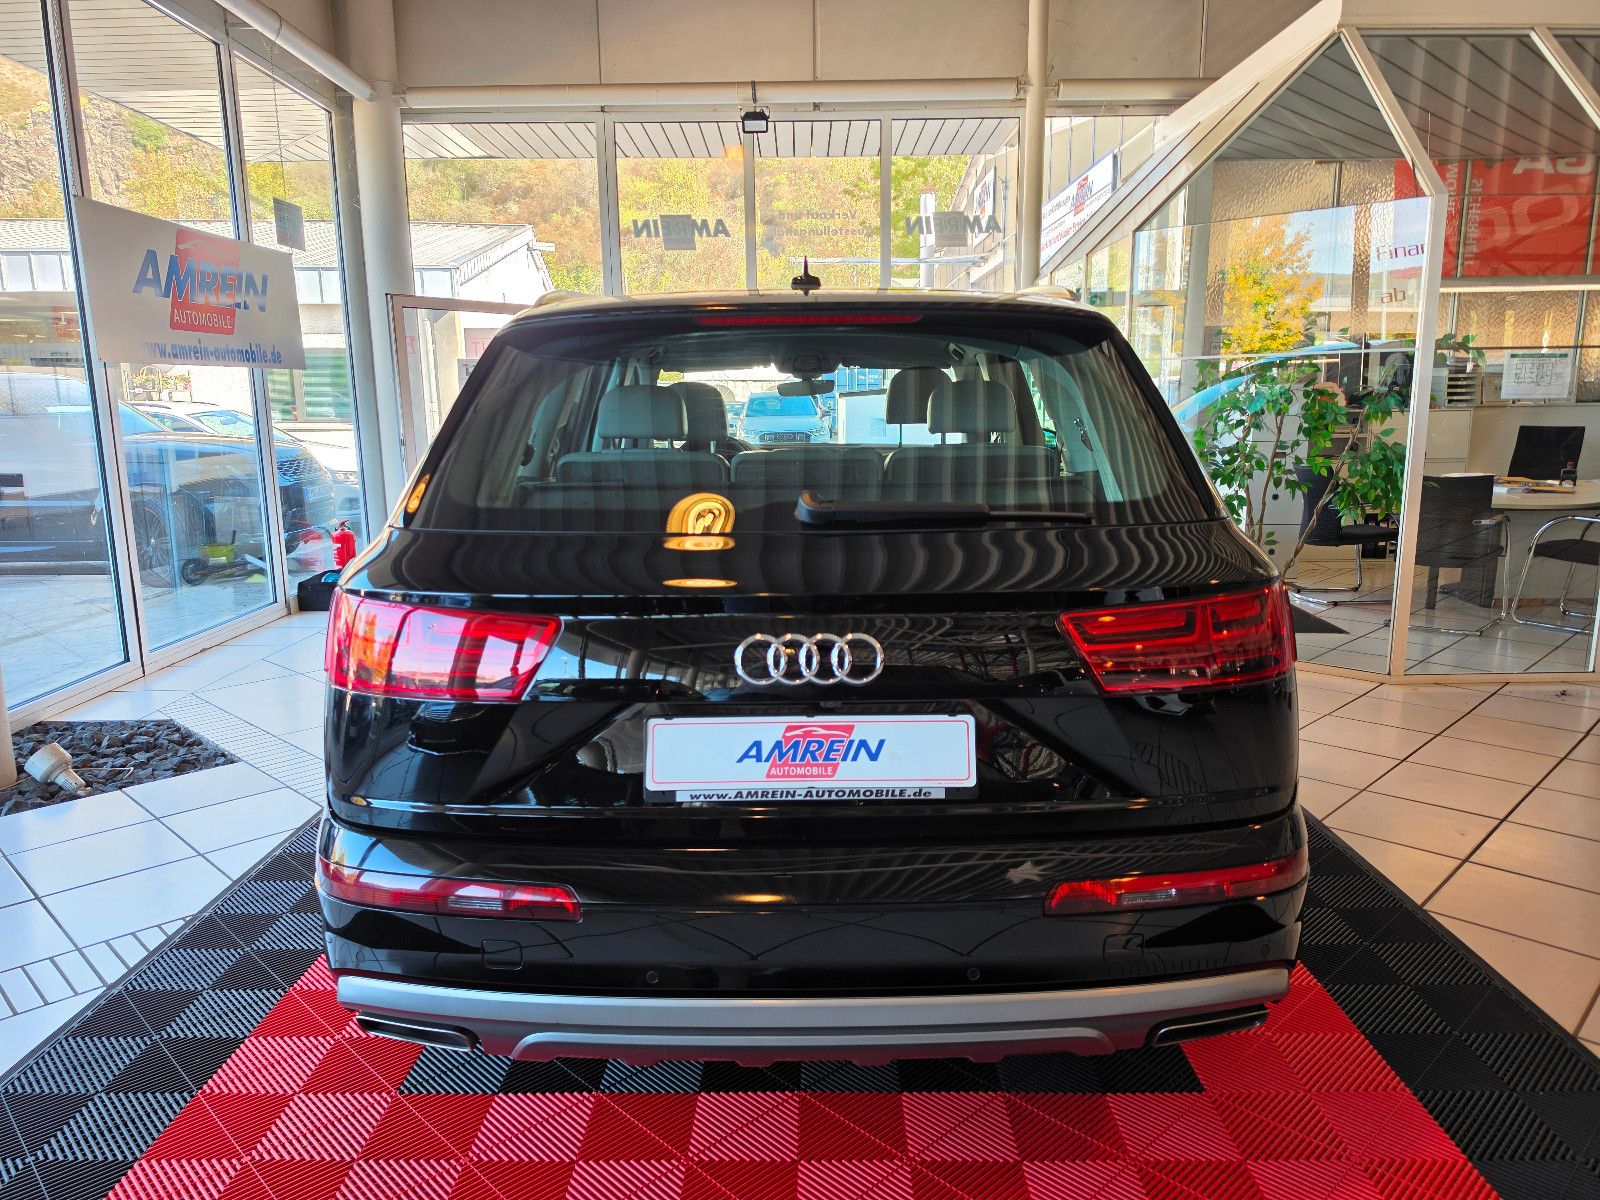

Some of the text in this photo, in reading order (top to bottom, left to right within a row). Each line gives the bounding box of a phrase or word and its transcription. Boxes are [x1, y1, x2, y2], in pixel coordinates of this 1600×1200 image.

[133, 248, 268, 313] AMREIN
[1381, 287, 1406, 303] ab
[173, 308, 233, 329] AUTOMOBILE
[735, 739, 886, 763] AMREIN
[769, 765, 833, 776] AUTOMOBILE
[689, 787, 932, 800] www.AMREIN-AUTOMOBILE.de
